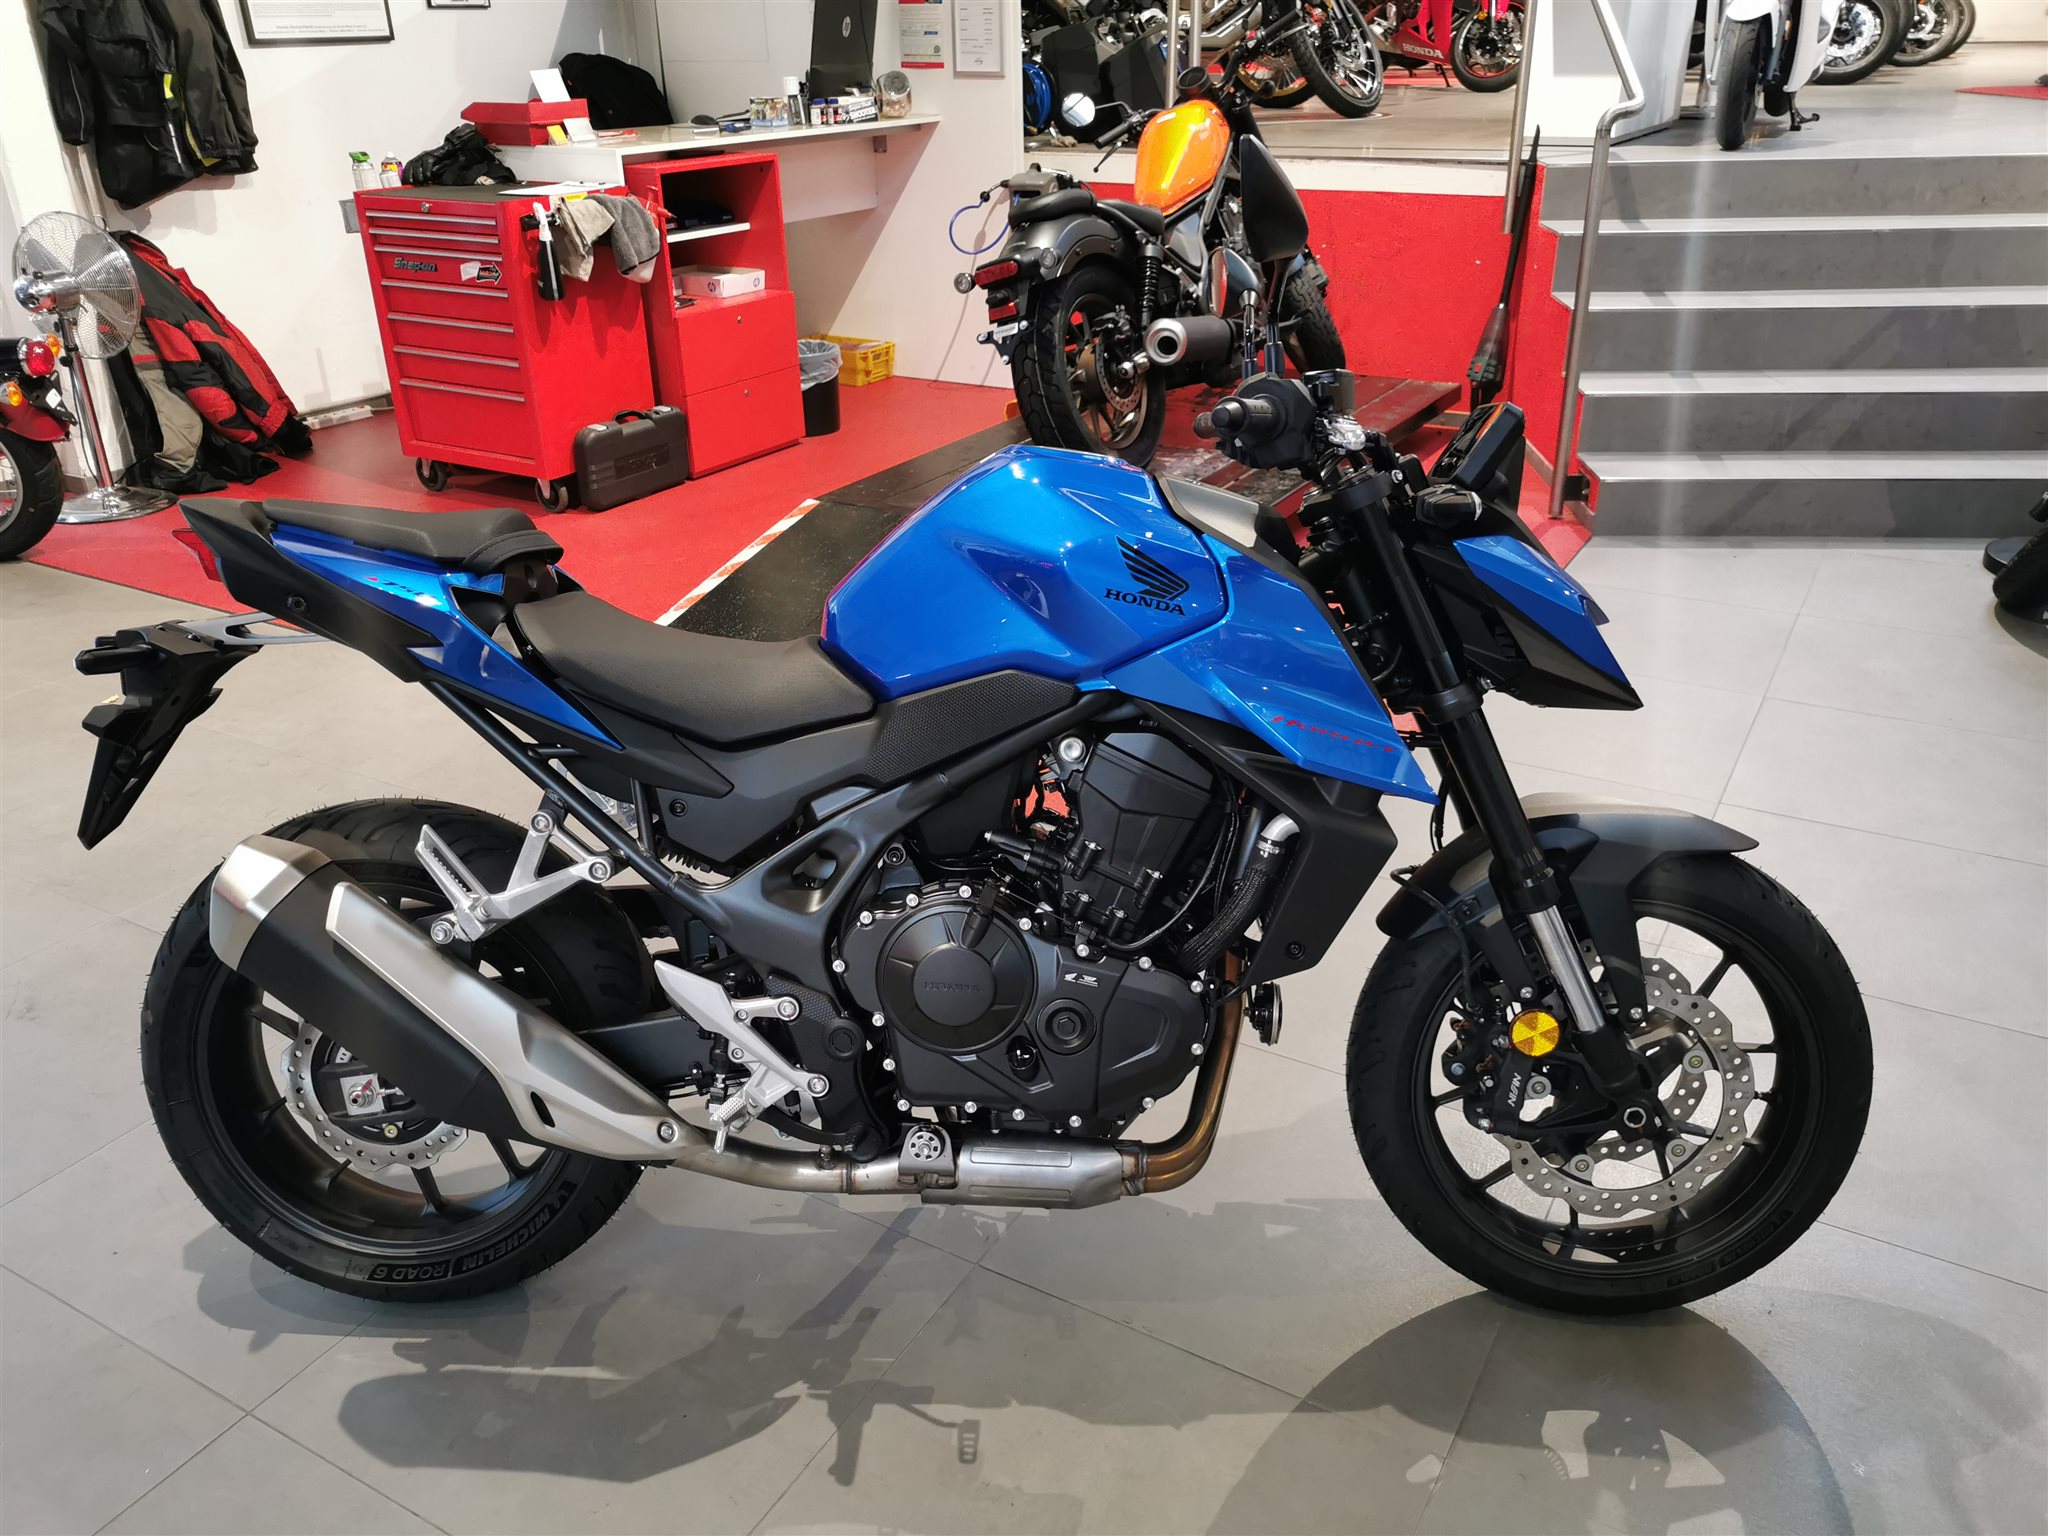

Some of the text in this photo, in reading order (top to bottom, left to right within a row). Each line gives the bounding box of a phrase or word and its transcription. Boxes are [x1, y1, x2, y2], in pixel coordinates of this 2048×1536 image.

[1402, 43, 1444, 59] HONDA
[1104, 588, 1186, 616] HONDA
[373, 1206, 550, 1280] MICHELIN ROAD 6
